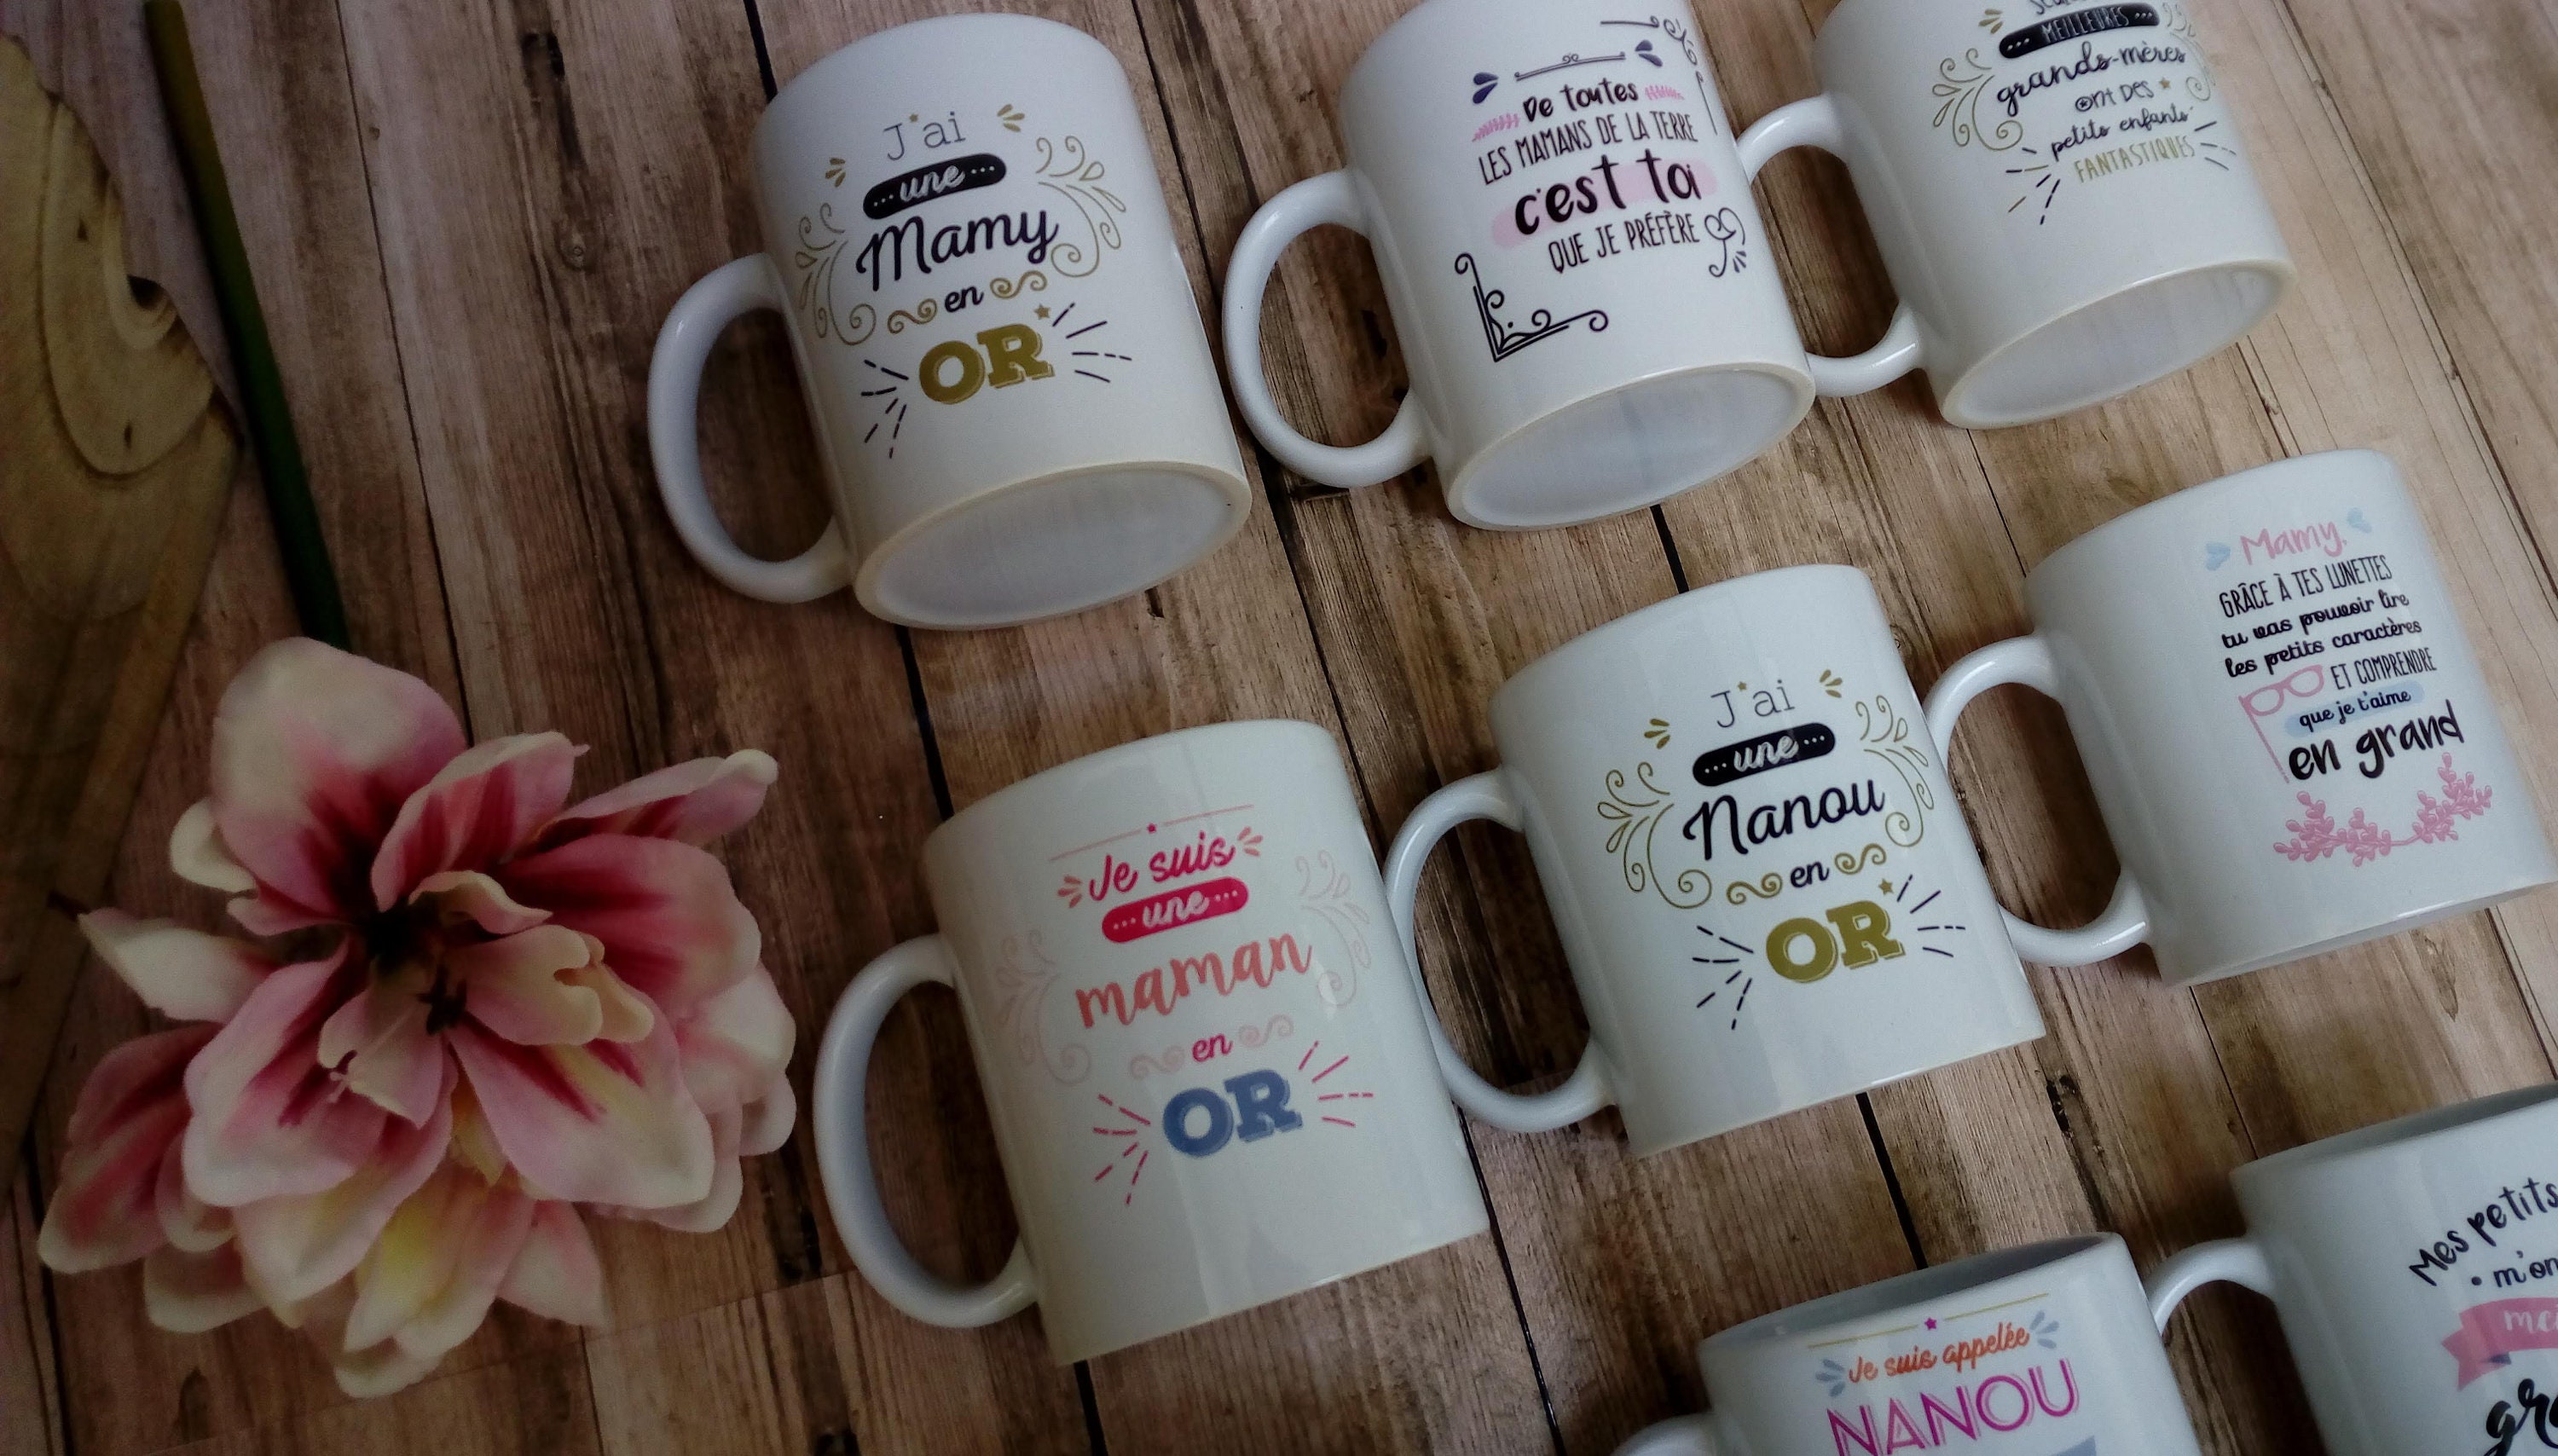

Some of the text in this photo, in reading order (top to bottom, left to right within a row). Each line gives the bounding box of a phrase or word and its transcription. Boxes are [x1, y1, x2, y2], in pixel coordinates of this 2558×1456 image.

[2041, 6, 2130, 43] MEILLEURES
[1523, 78, 1639, 122] De toutes
[1997, 41, 2186, 117] grands-mères
[883, 111, 966, 161] J'ai
[1479, 110, 1699, 185] LES MAMANS DE LA TERRE
[2052, 102, 2190, 162] petits enfants
[2074, 135, 2196, 183] FANTASTIQUES
[900, 165, 965, 203] une
[1515, 154, 1627, 234] c'est
[856, 210, 1059, 291] Mamy
[1548, 211, 1700, 274] QUE JE PRÉFÈRE
[945, 284, 984, 312] en
[919, 324, 1056, 405] OR
[2219, 554, 2393, 618] GRÂCE À TES LUNETTES
[2222, 589, 2410, 650] tu vas pouvoir lire
[2225, 616, 2422, 678] les petits caractères
[2330, 647, 2438, 690] ET COMPRENDRE
[1710, 679, 1796, 728] J'ai
[2300, 690, 2411, 733] que je t'aime
[1733, 735, 1799, 771] une
[2289, 699, 2465, 780] en grand
[1682, 779, 1885, 861] Nanou
[1089, 830, 1236, 901] Je suis
[1791, 861, 1830, 888] en
[1142, 890, 1211, 928] une
[1766, 899, 1907, 984] OR
[1075, 933, 1313, 1029] maman
[1192, 1033, 1233, 1062] en
[1163, 1069, 1304, 1158] OR
[2409, 1176, 2558, 1286] Mes petits
[1848, 1321, 2030, 1384] Je suis appelée
[1826, 1357, 2081, 1456] NANOU
